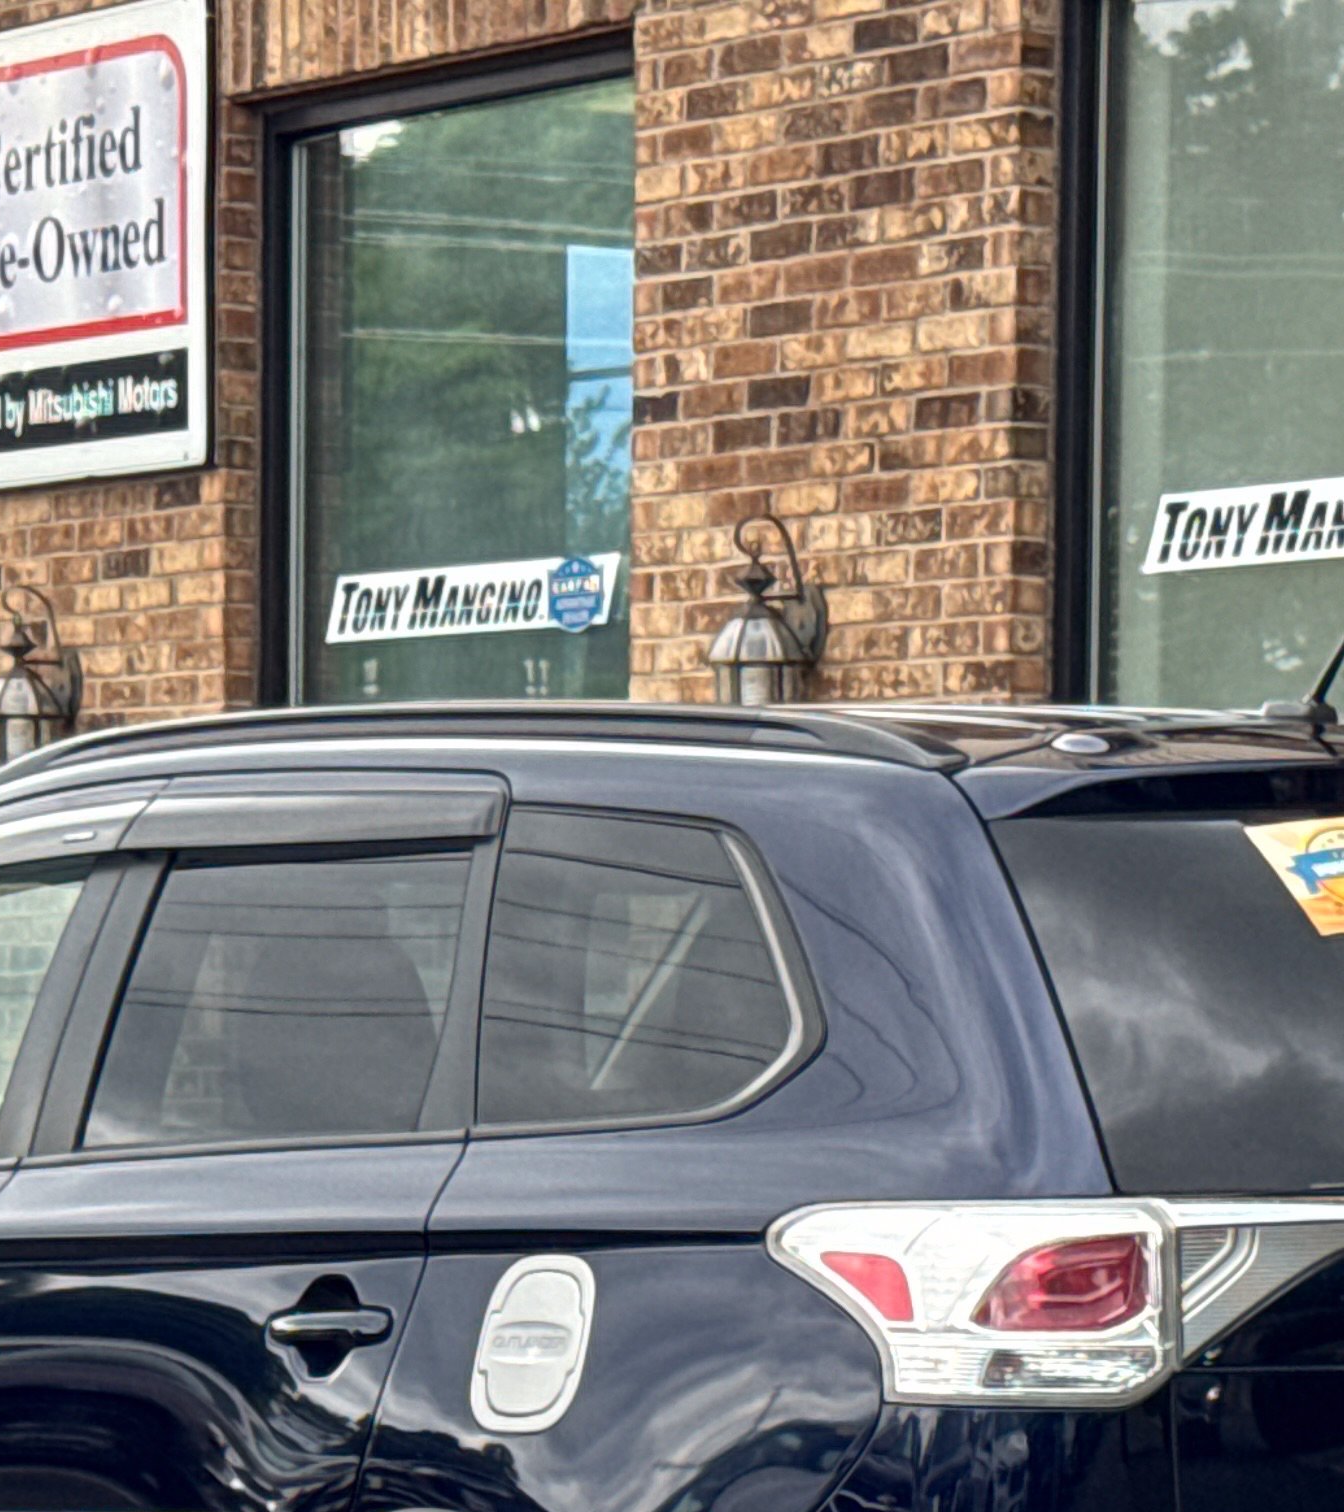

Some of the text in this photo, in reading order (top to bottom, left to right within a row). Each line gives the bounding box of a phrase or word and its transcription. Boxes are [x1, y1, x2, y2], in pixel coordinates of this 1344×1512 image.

[6, 392, 25, 438] by
[28, 378, 114, 424] Mitsubishi
[117, 375, 178, 415] Motors
[1158, 500, 1259, 564] TONY
[337, 575, 543, 635] TONY MANGINO
